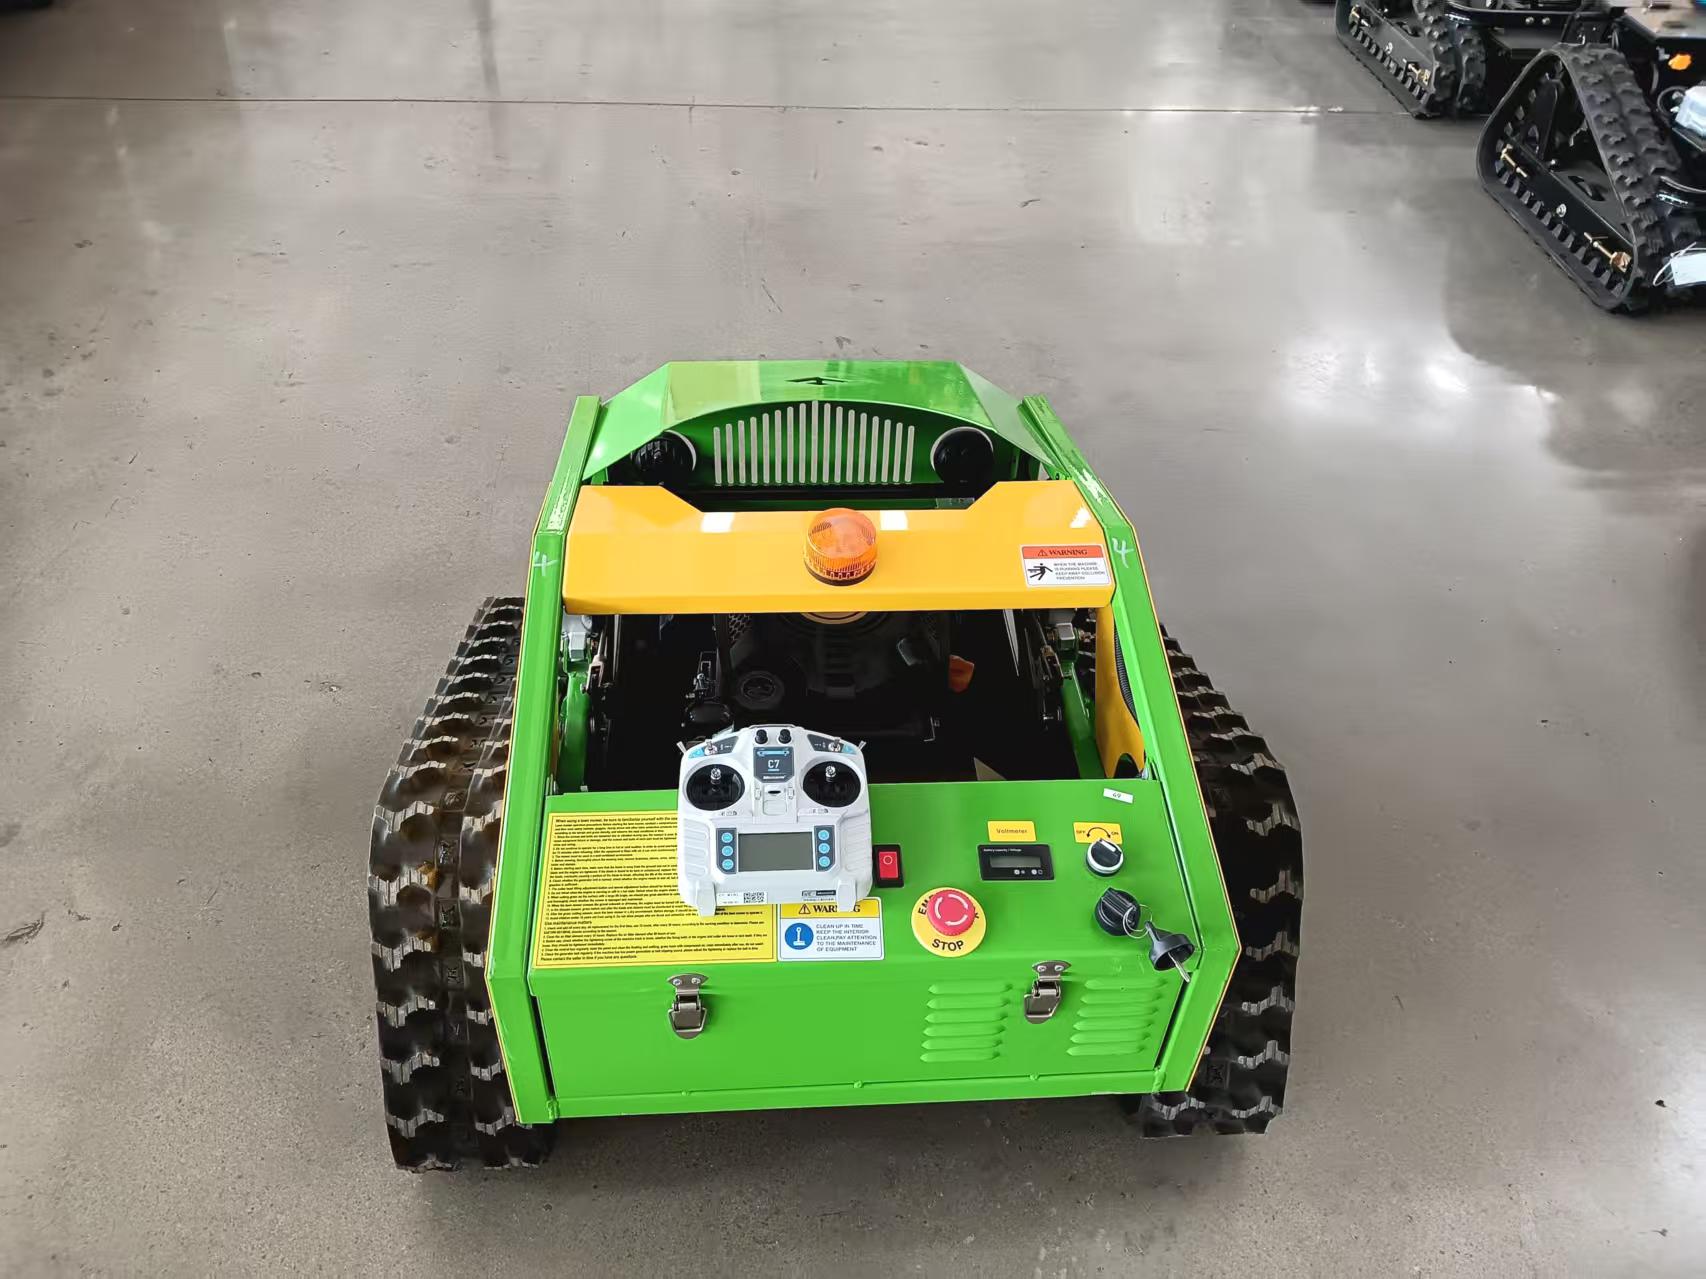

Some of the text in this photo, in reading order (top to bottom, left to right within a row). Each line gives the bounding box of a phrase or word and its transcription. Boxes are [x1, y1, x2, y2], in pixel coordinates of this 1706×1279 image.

[1111, 537, 1134, 569] 4
[767, 759, 780, 769] C7
[813, 904, 861, 913] WARG
[932, 938, 964, 952] STOP
